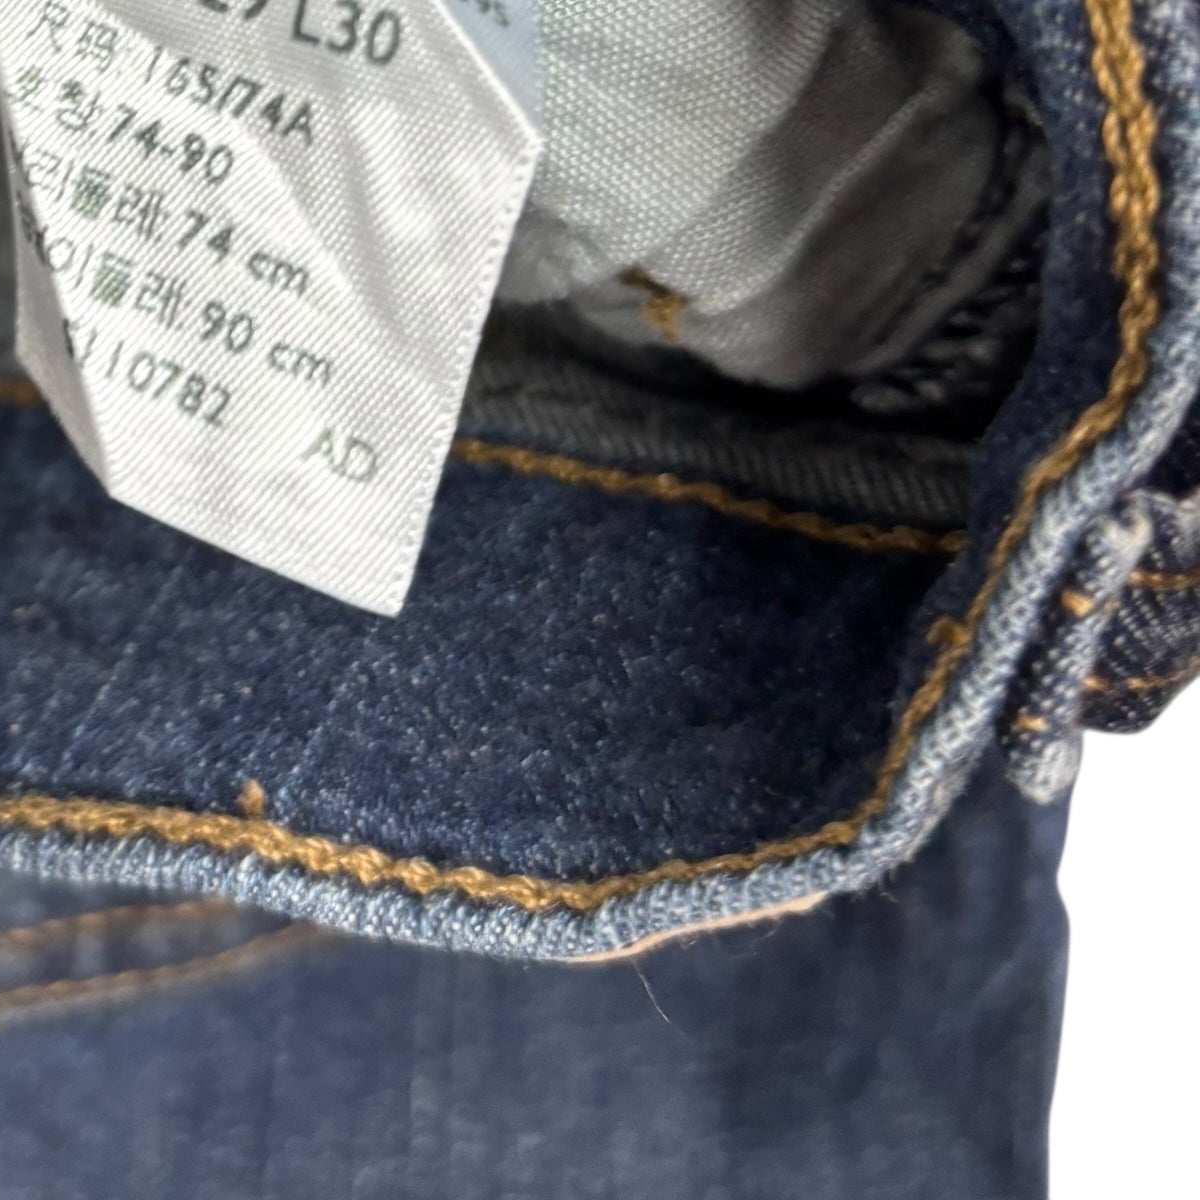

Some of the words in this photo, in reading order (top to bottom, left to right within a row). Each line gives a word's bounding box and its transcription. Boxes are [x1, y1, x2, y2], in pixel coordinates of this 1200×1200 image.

[179, 209, 234, 263] 74
[247, 250, 311, 295] cm
[201, 300, 253, 353] 90
[268, 341, 332, 389] cm
[309, 428, 380, 482] AD
